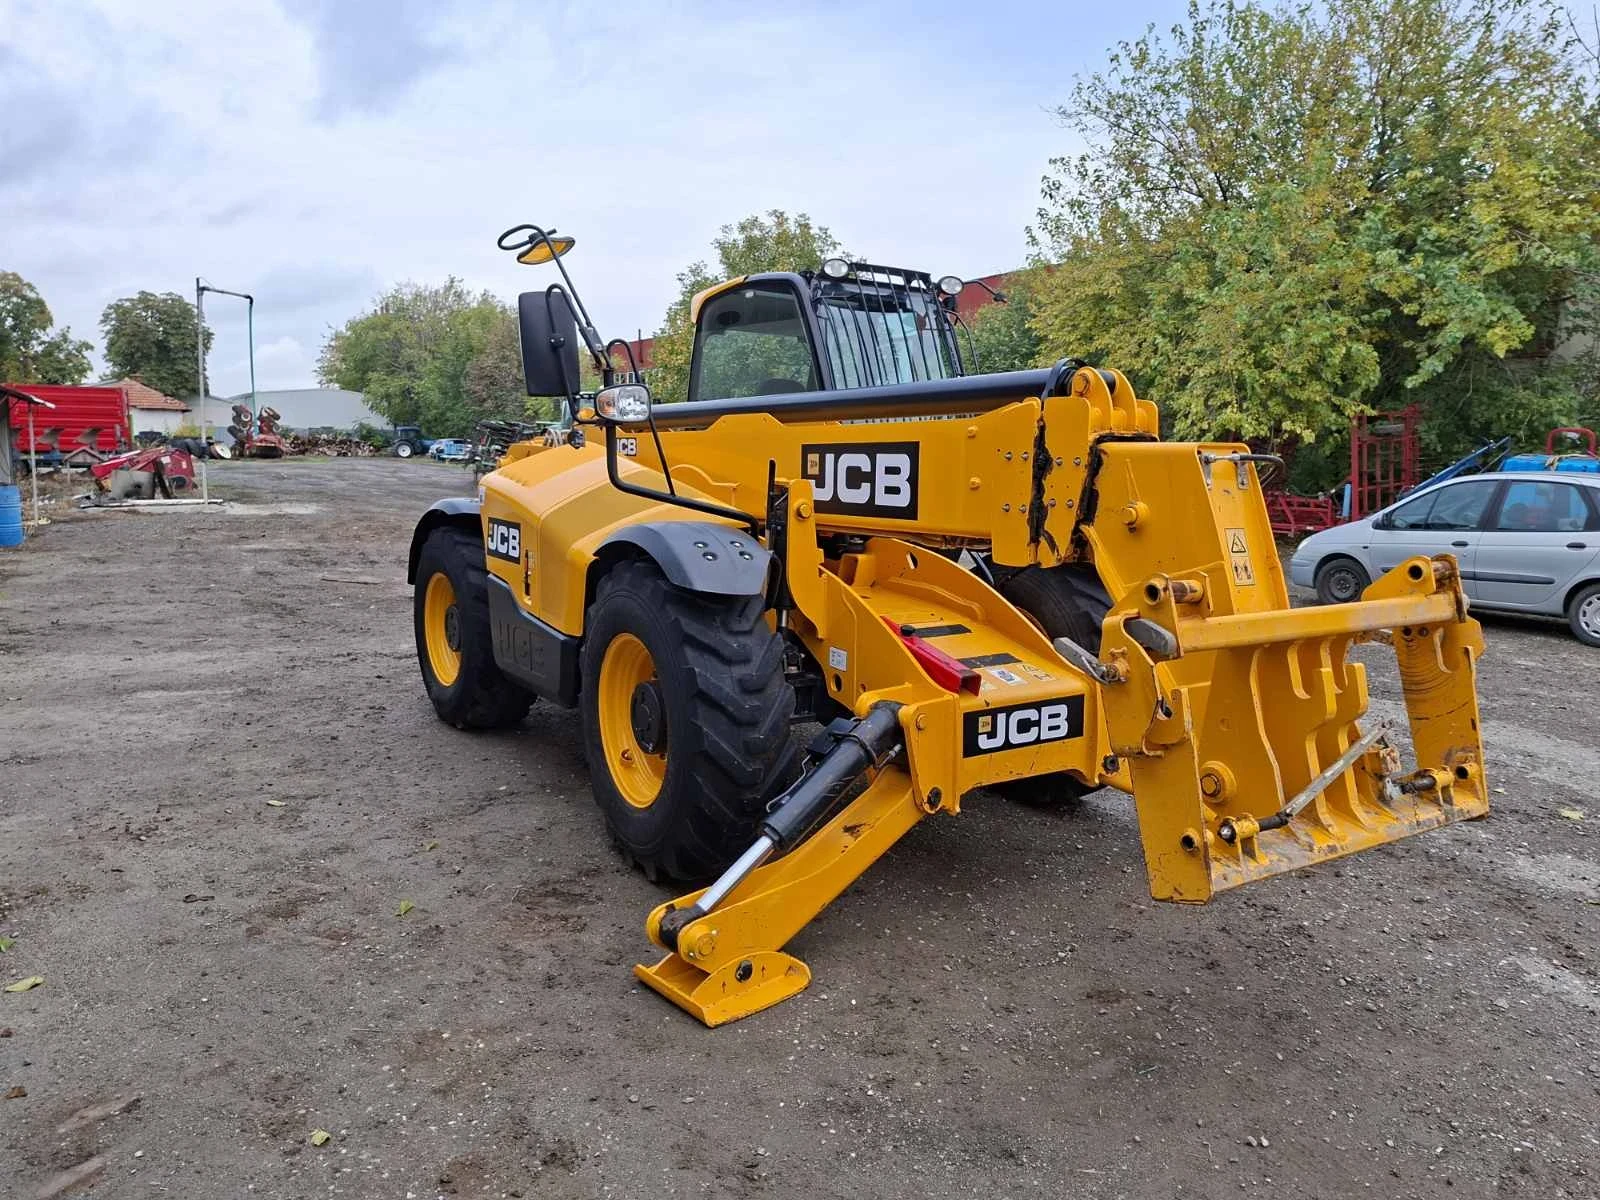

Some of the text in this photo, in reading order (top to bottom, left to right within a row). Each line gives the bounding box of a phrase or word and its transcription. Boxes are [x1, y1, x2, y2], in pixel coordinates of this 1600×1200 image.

[807, 453, 911, 507] JCB
[487, 523, 520, 558] JCB
[977, 703, 1069, 750] JCB
